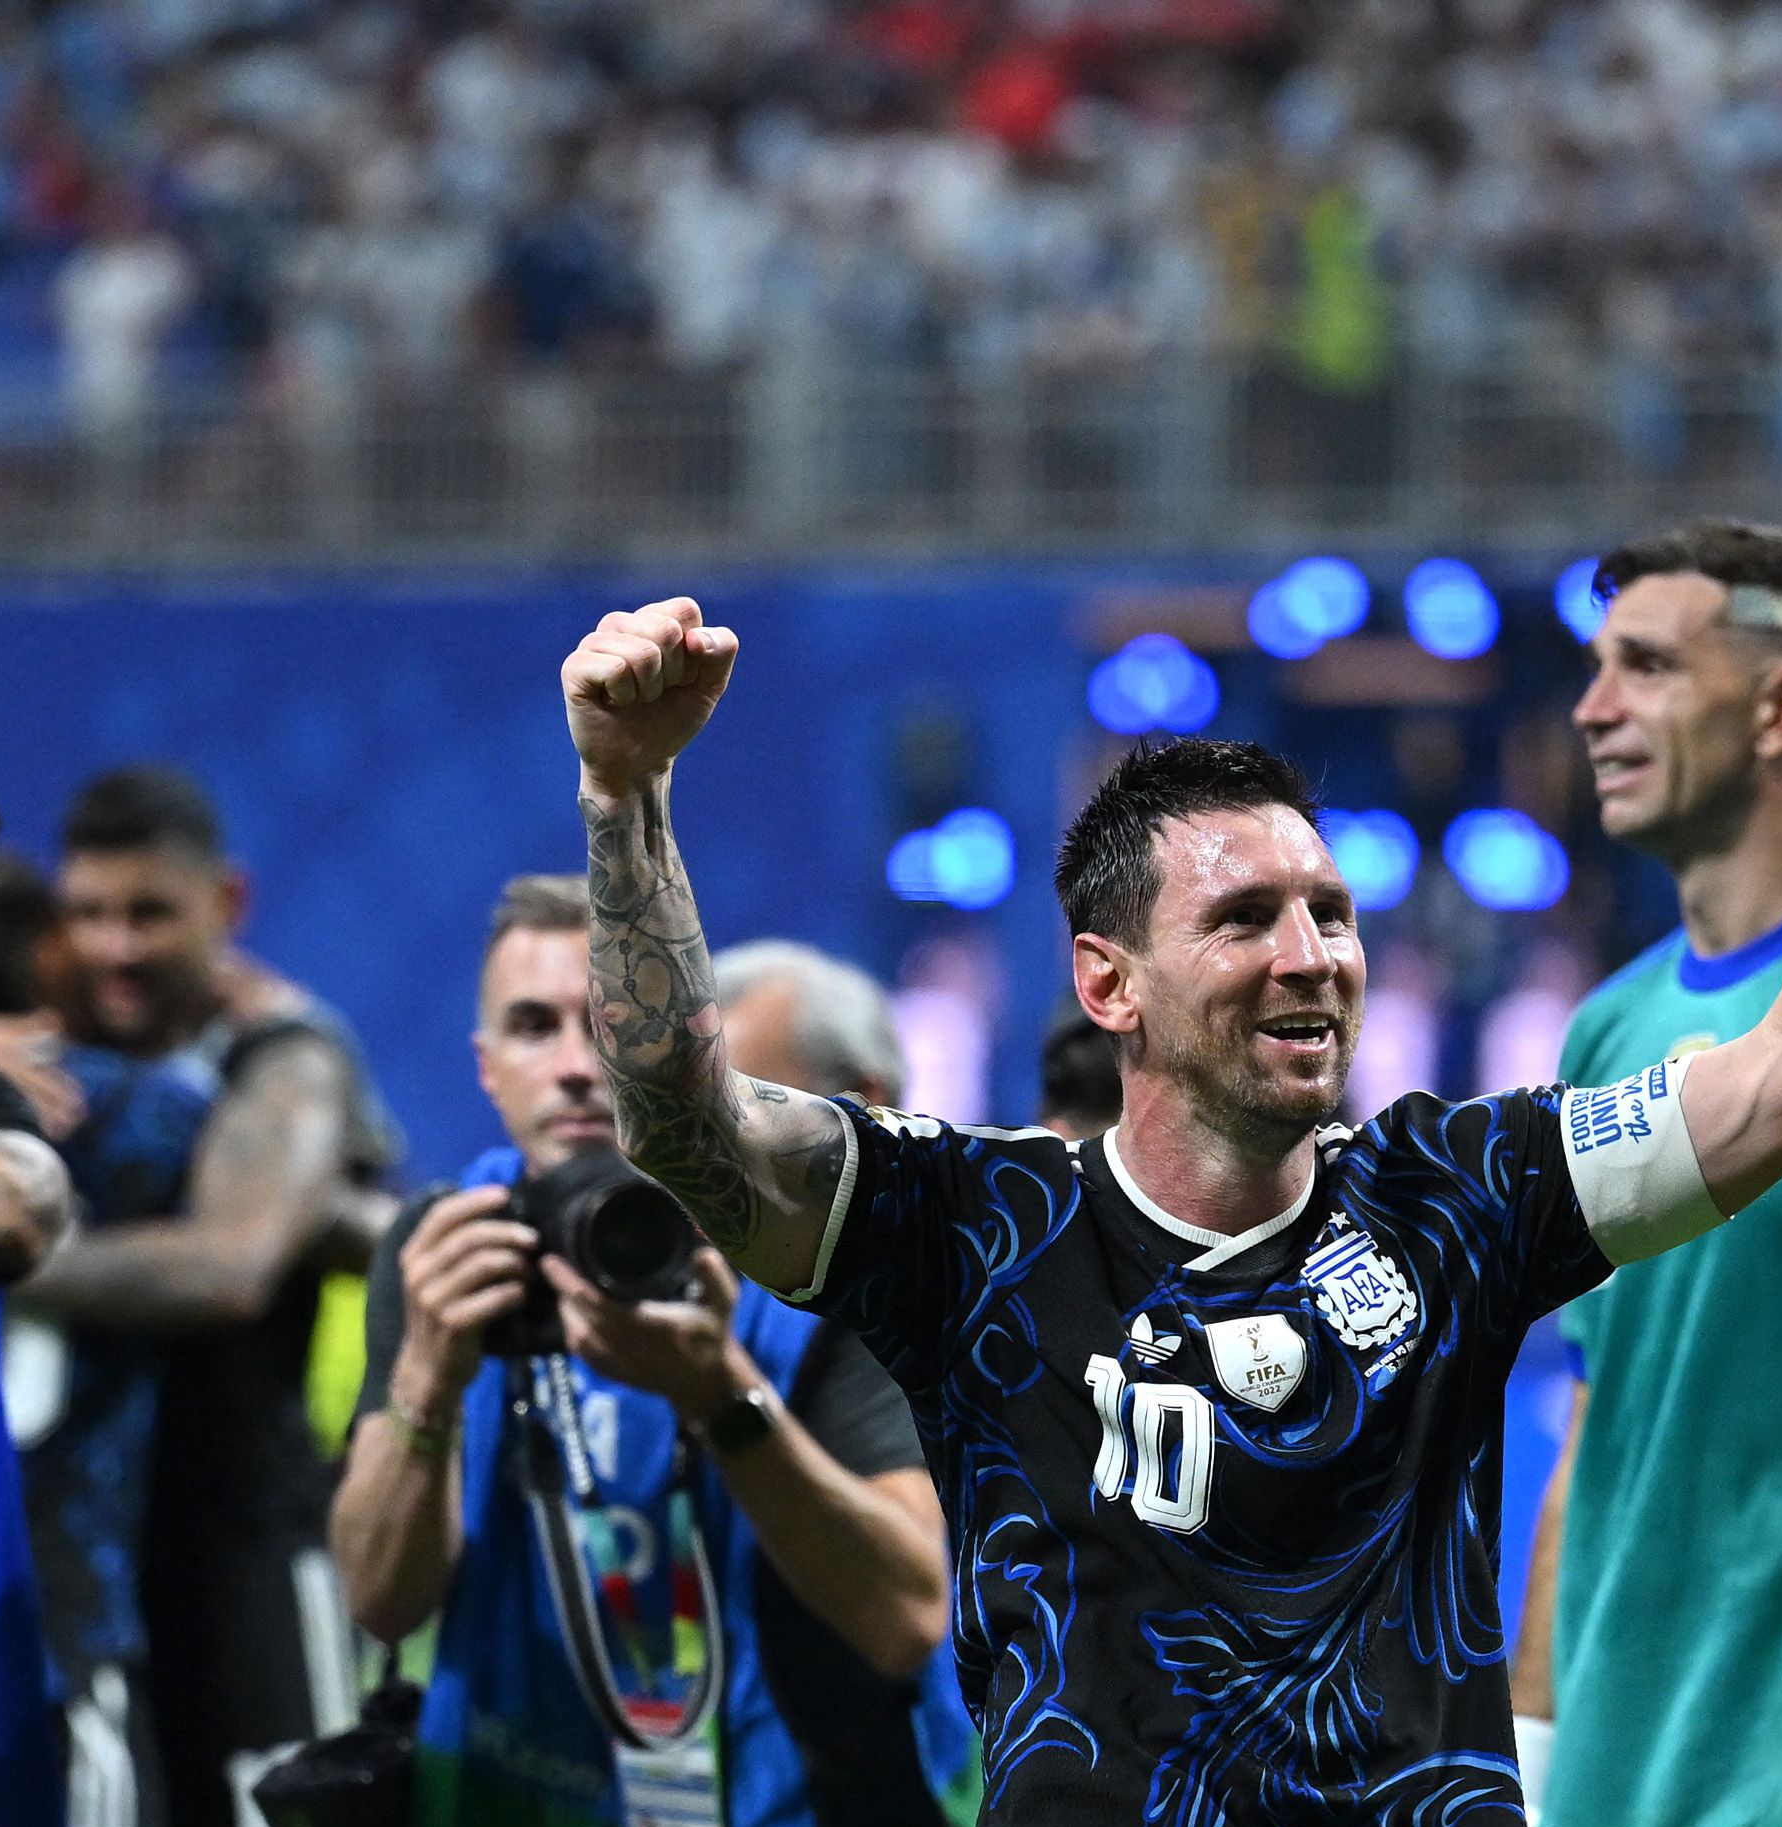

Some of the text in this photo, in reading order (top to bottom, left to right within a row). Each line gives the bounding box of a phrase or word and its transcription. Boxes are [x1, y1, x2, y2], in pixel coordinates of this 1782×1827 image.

[1591, 1086, 1622, 1147] UNIT
[1246, 1363, 1286, 1385] FIFA
[1258, 1385, 1282, 1398] 2022
[1084, 1353, 1215, 1535] 10
